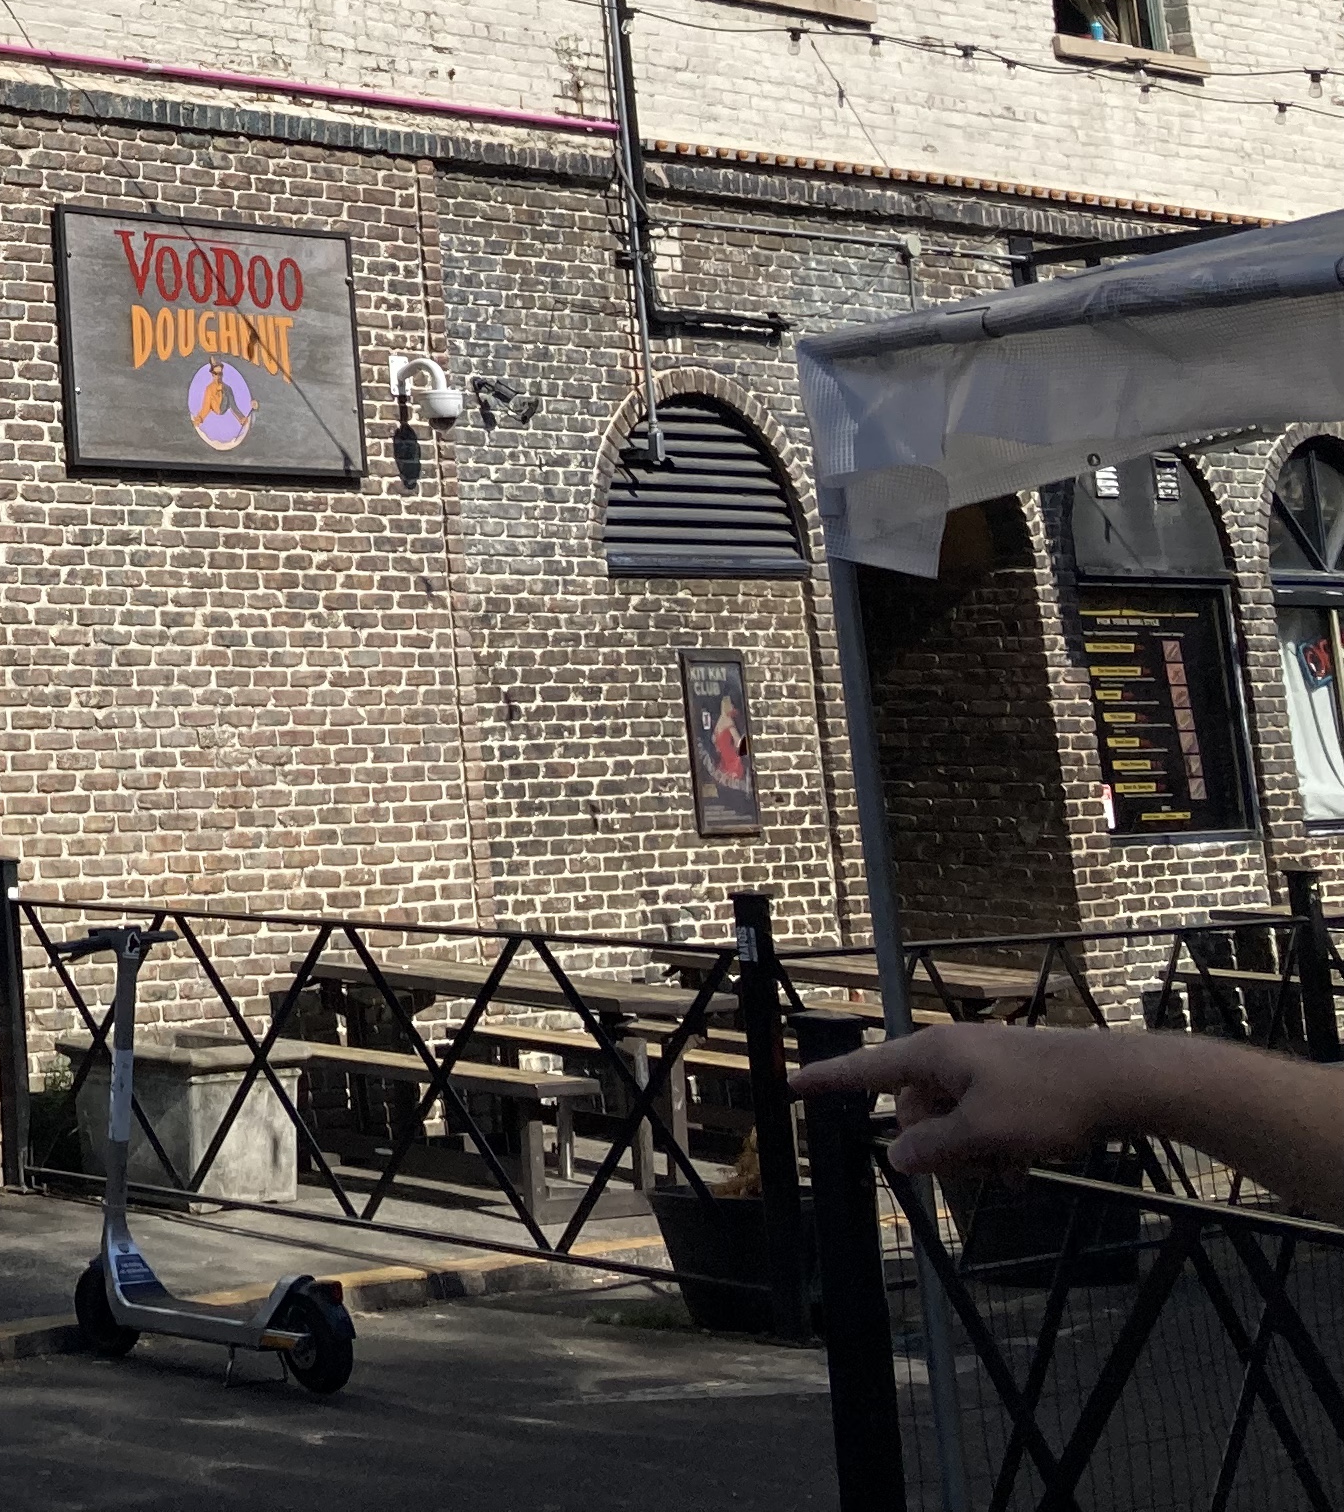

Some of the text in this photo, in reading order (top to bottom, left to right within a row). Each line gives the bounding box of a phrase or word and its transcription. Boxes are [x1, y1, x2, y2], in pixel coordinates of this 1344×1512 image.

[114, 229, 305, 312] VOODOO
[131, 304, 295, 385] DOUGHNUT
[689, 666, 706, 681] KIT
[694, 681, 721, 696] CLUB
